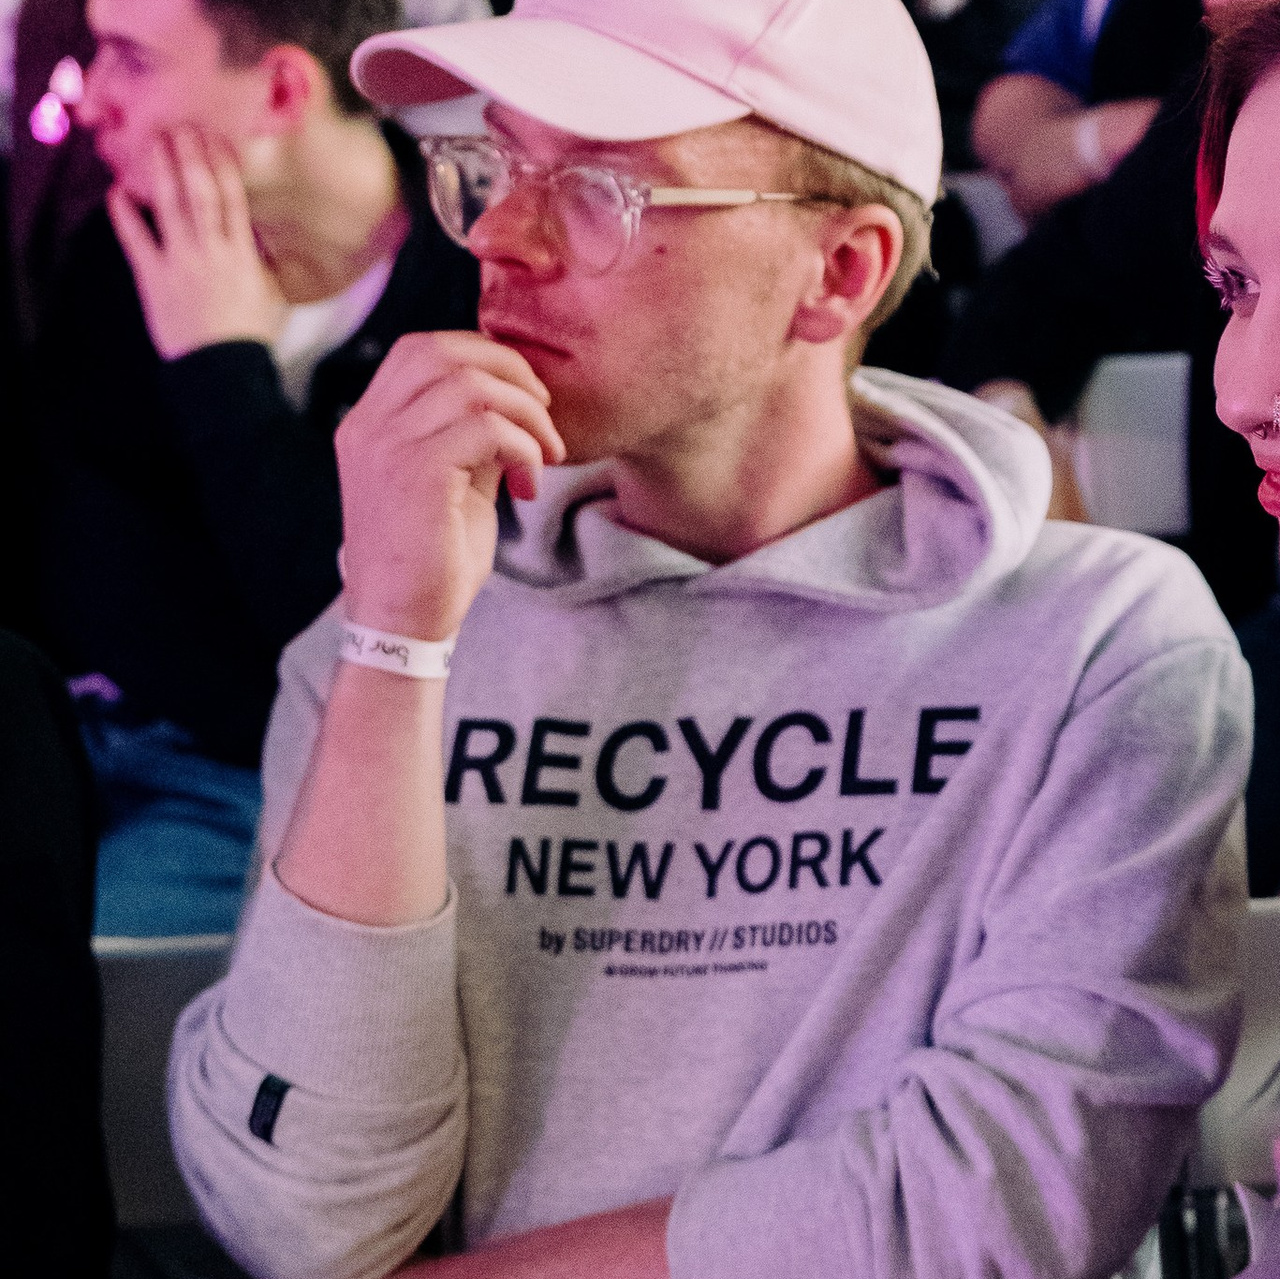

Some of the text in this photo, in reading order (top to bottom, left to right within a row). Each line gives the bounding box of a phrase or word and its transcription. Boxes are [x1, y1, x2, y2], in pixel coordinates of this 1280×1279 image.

[444, 705, 982, 812] RECYCLE
[505, 827, 886, 901] NEW YORK
[538, 926, 566, 956] by
[572, 925, 704, 954] SUPERDRY
[732, 919, 839, 950] STUDIOS
